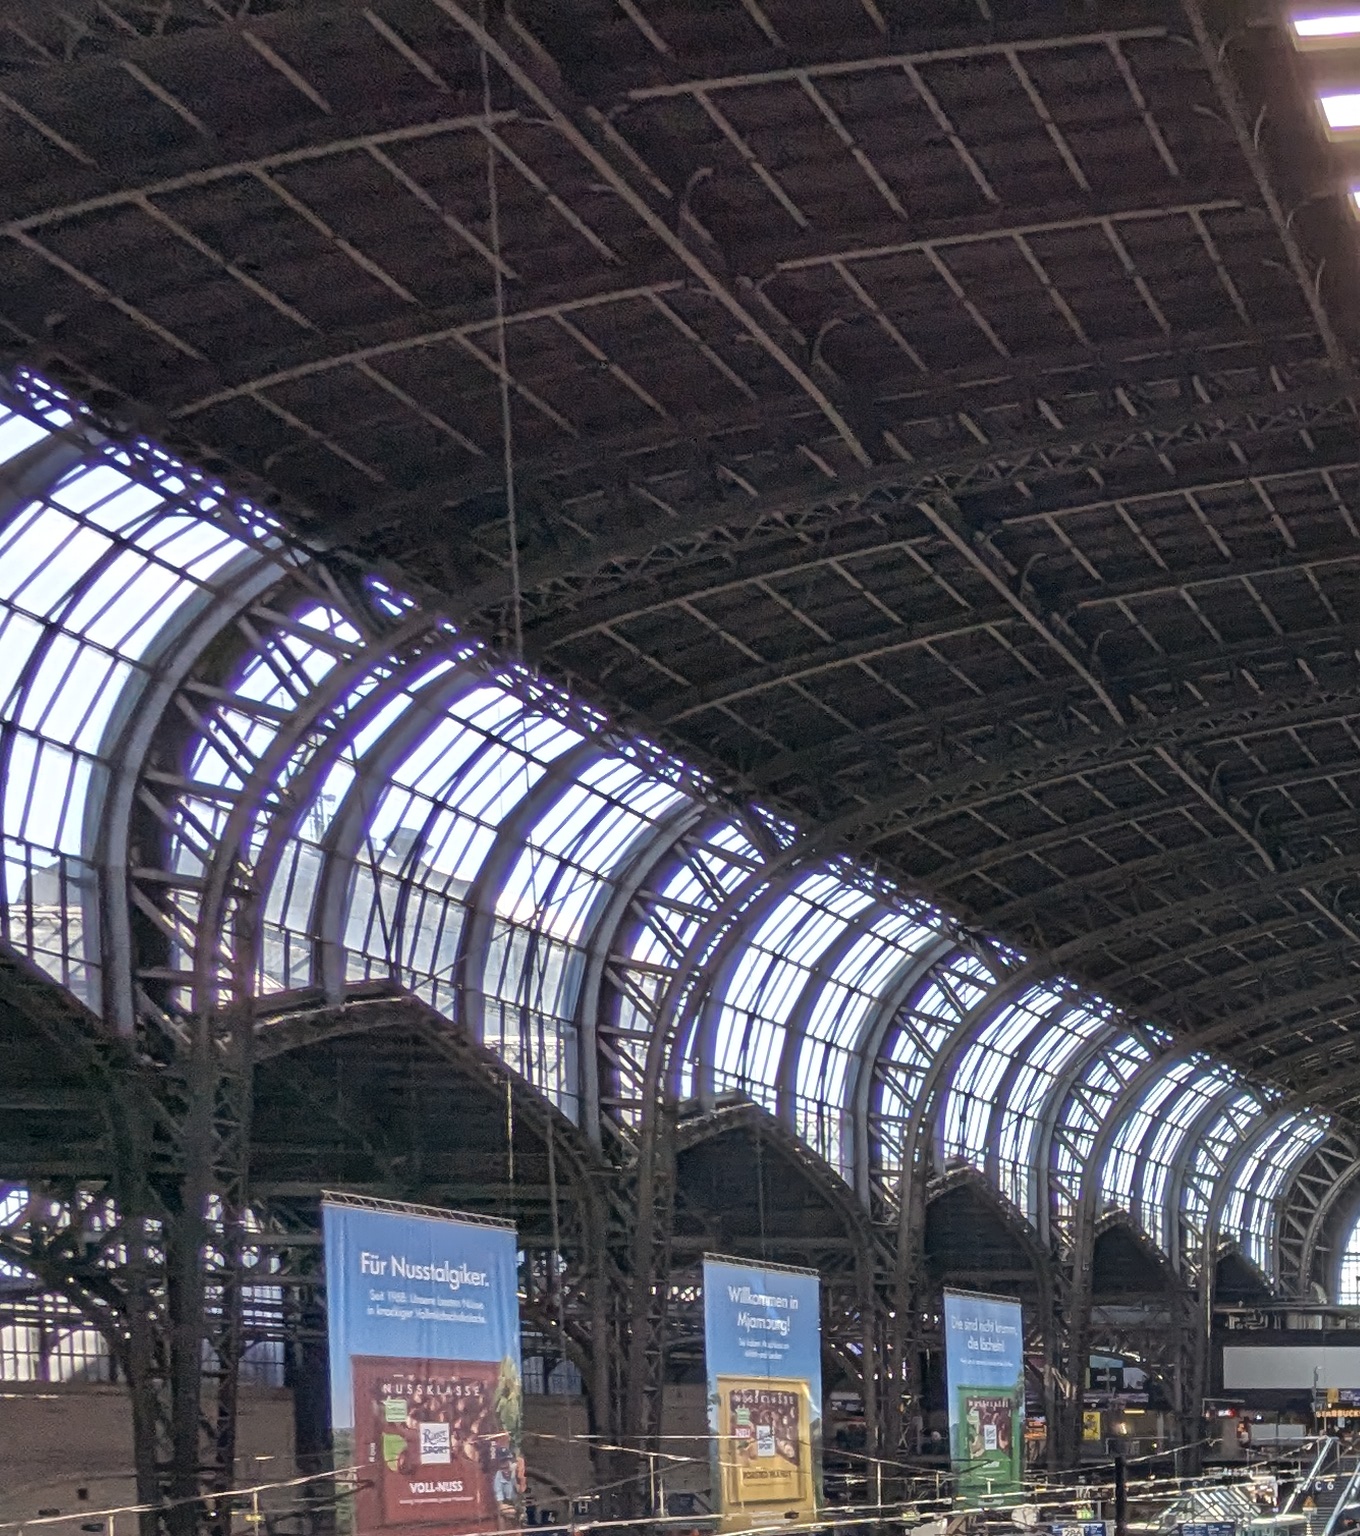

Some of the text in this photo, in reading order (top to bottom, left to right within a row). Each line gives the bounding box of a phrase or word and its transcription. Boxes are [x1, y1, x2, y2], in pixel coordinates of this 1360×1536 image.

[361, 1252, 489, 1290] Für Nusstalgiker.
[789, 1295, 798, 1310] in
[384, 1383, 480, 1396] NUSSKLASSE
[408, 1480, 464, 1495] VOLL-NUSS
[1315, 1481, 1334, 1490] C 6
